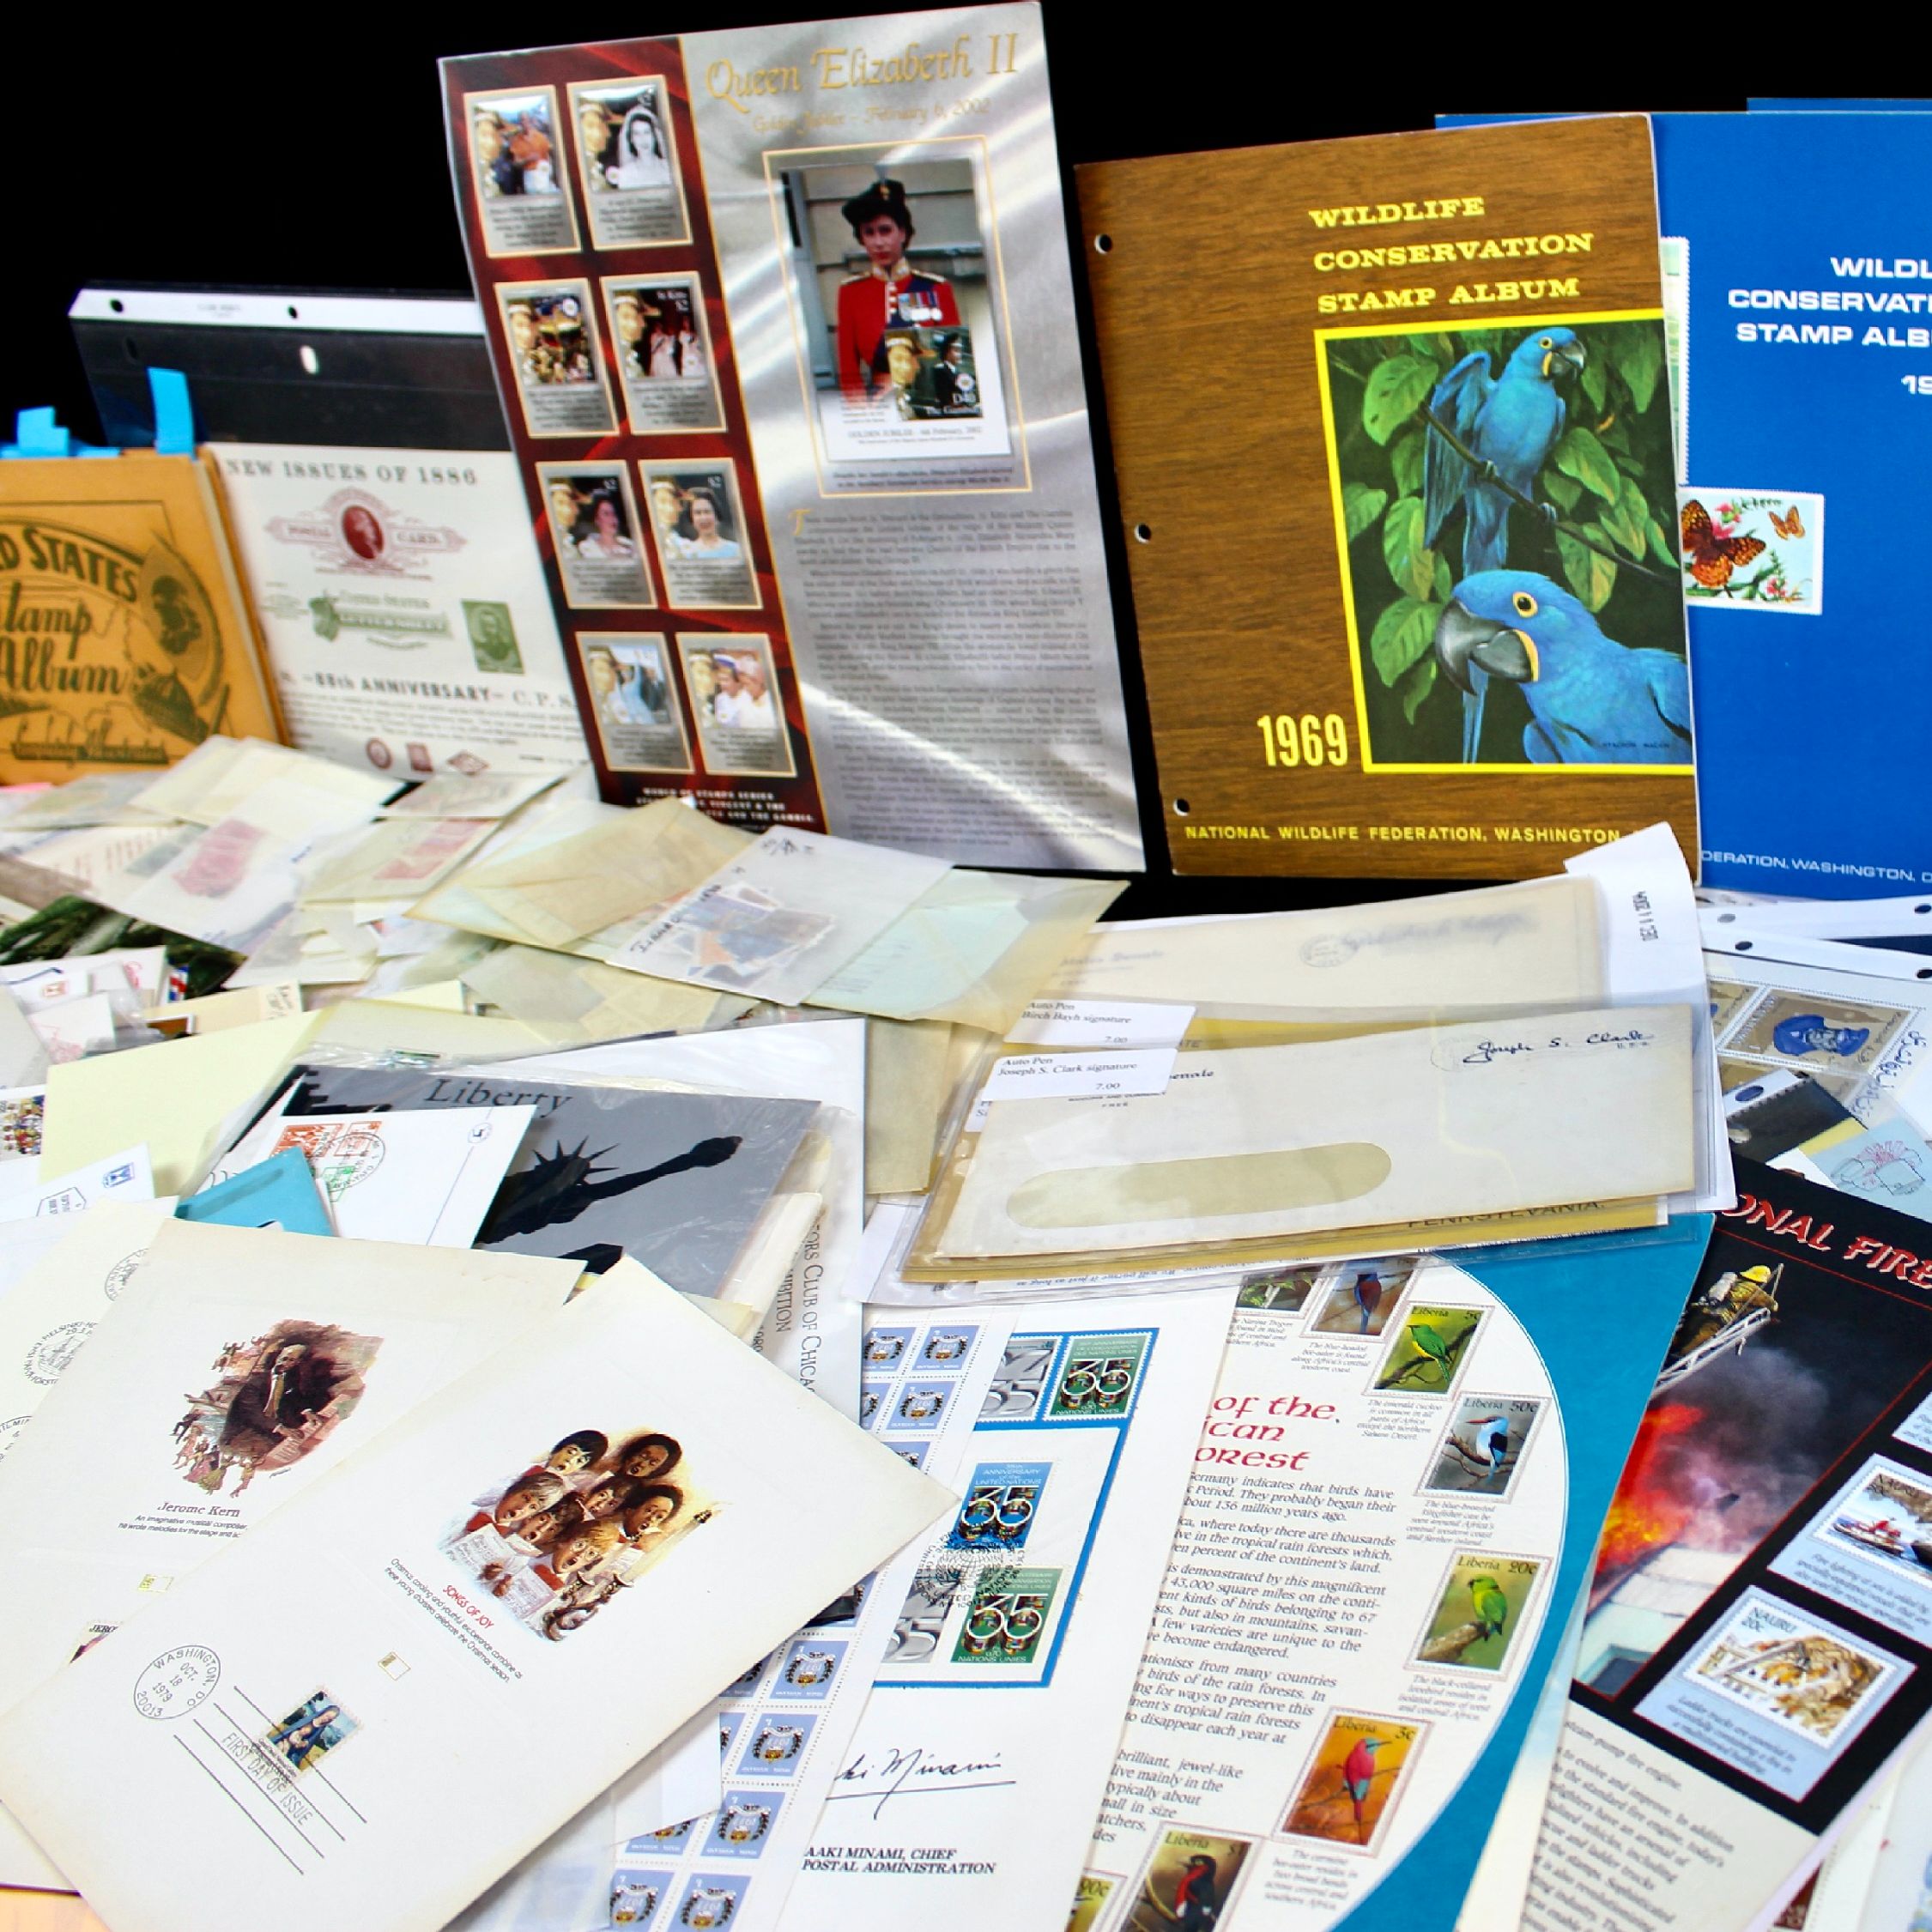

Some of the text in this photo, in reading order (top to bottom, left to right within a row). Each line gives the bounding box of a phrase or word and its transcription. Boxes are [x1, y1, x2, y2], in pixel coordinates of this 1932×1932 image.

[706, 33, 1018, 114] Queen Elizabeth II
[1309, 197, 1485, 229] WILDLIFE
[1313, 233, 1594, 272] CONSERVATION
[1317, 277, 1579, 314] STAMP ALBUM
[1736, 323, 1852, 344] STAMP
[227, 459, 272, 476] NEW
[284, 461, 367, 480] ISSUES
[377, 464, 406, 483] OF
[22, 525, 137, 603] STATES
[1257, 714, 1348, 767] 1969
[1185, 826, 1270, 840] NATIONAL
[1279, 827, 1359, 840] WILDLIFE
[1369, 827, 1488, 843] FEDERATION,
[1791, 859, 1916, 882] WASHINGTON,
[1083, 1014, 1131, 1024] signature
[1003, 1057, 1030, 1065] Auto
[1053, 1064, 1081, 1074] Clark
[1086, 1063, 1137, 1073] signature
[1169, 1070, 1214, 1081] enate
[424, 1078, 570, 1118] Liberty
[803, 1264, 824, 1311] CLUB
[802, 1311, 818, 1330] OF
[1213, 1395, 1336, 1420] of the
[1242, 1476, 1395, 1499] indicates that birds have
[157, 1502, 240, 1517] Jerome Kern
[1195, 1486, 1396, 1513] Period. They probably began their
[1241, 1502, 1282, 1516] million
[1284, 1506, 1318, 1520] years
[1321, 1511, 1348, 1523] ago.
[148, 1524, 178, 1533] melodies
[1200, 1519, 1396, 1547] where today there are thousands
[1231, 1534, 1393, 1561] tropical rain forests which,
[1191, 1546, 1236, 1560] percent
[1350, 1560, 1381, 1574] land.
[1457, 1555, 1500, 1572] Liberia
[1181, 1564, 1386, 1596] demonstrated magnificent
[385, 1566, 399, 1581] these
[397, 1578, 415, 1596] young
[458, 1632, 469, 1644] the
[442, 1584, 494, 1630] SONGS OF JOY
[1249, 1616, 1318, 1633] mountains,
[1214, 1640, 1289, 1659] endangered.
[170, 1675, 183, 1687] 18
[180, 1662, 198, 1681] OCT.
[1276, 1672, 1337, 1689] countries
[136, 1692, 163, 1717] 20013
[1141, 1712, 1203, 1732] disappear
[221, 1732, 253, 1763] FIRST
[248, 1757, 273, 1783] DAY
[266, 1778, 287, 1796] OF
[280, 1790, 313, 1826] ISSUE
[1178, 1759, 1244, 1779] jewel-like
[1162, 1792, 1202, 1806] about
[803, 1847, 957, 1861] AAKI MINAMI, CHIEF
[802, 1860, 996, 1874] POSTAL ADMINISTRATION
